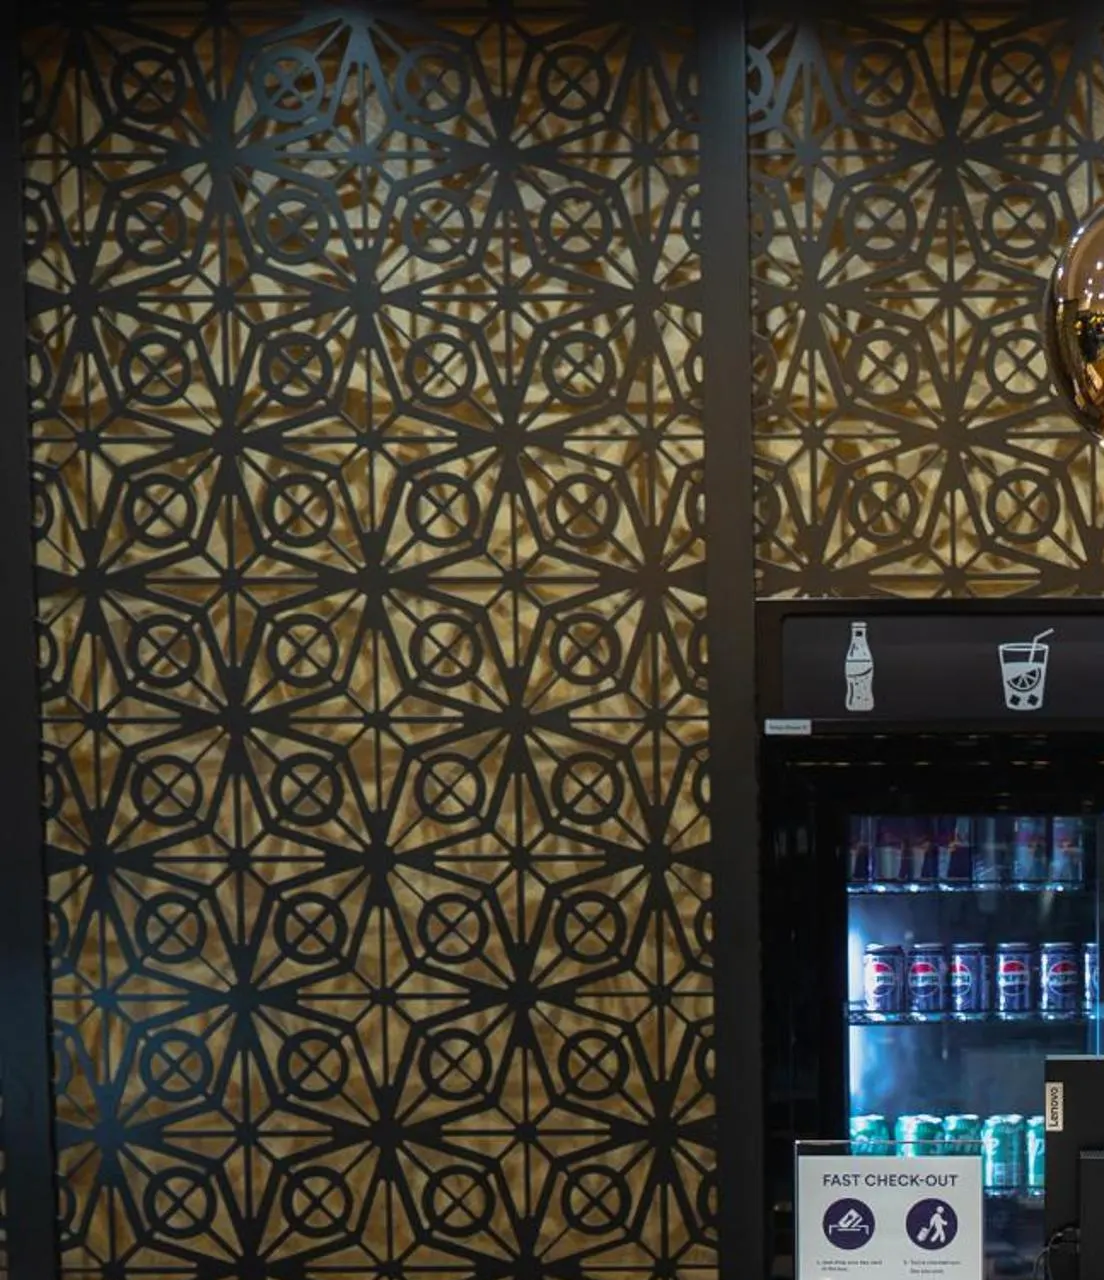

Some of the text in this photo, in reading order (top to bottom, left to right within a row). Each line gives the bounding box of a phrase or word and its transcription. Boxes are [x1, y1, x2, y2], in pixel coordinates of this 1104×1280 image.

[1049, 1086, 1059, 1127] Lenovo
[822, 1173, 959, 1188] FAST CHECK-OUT
